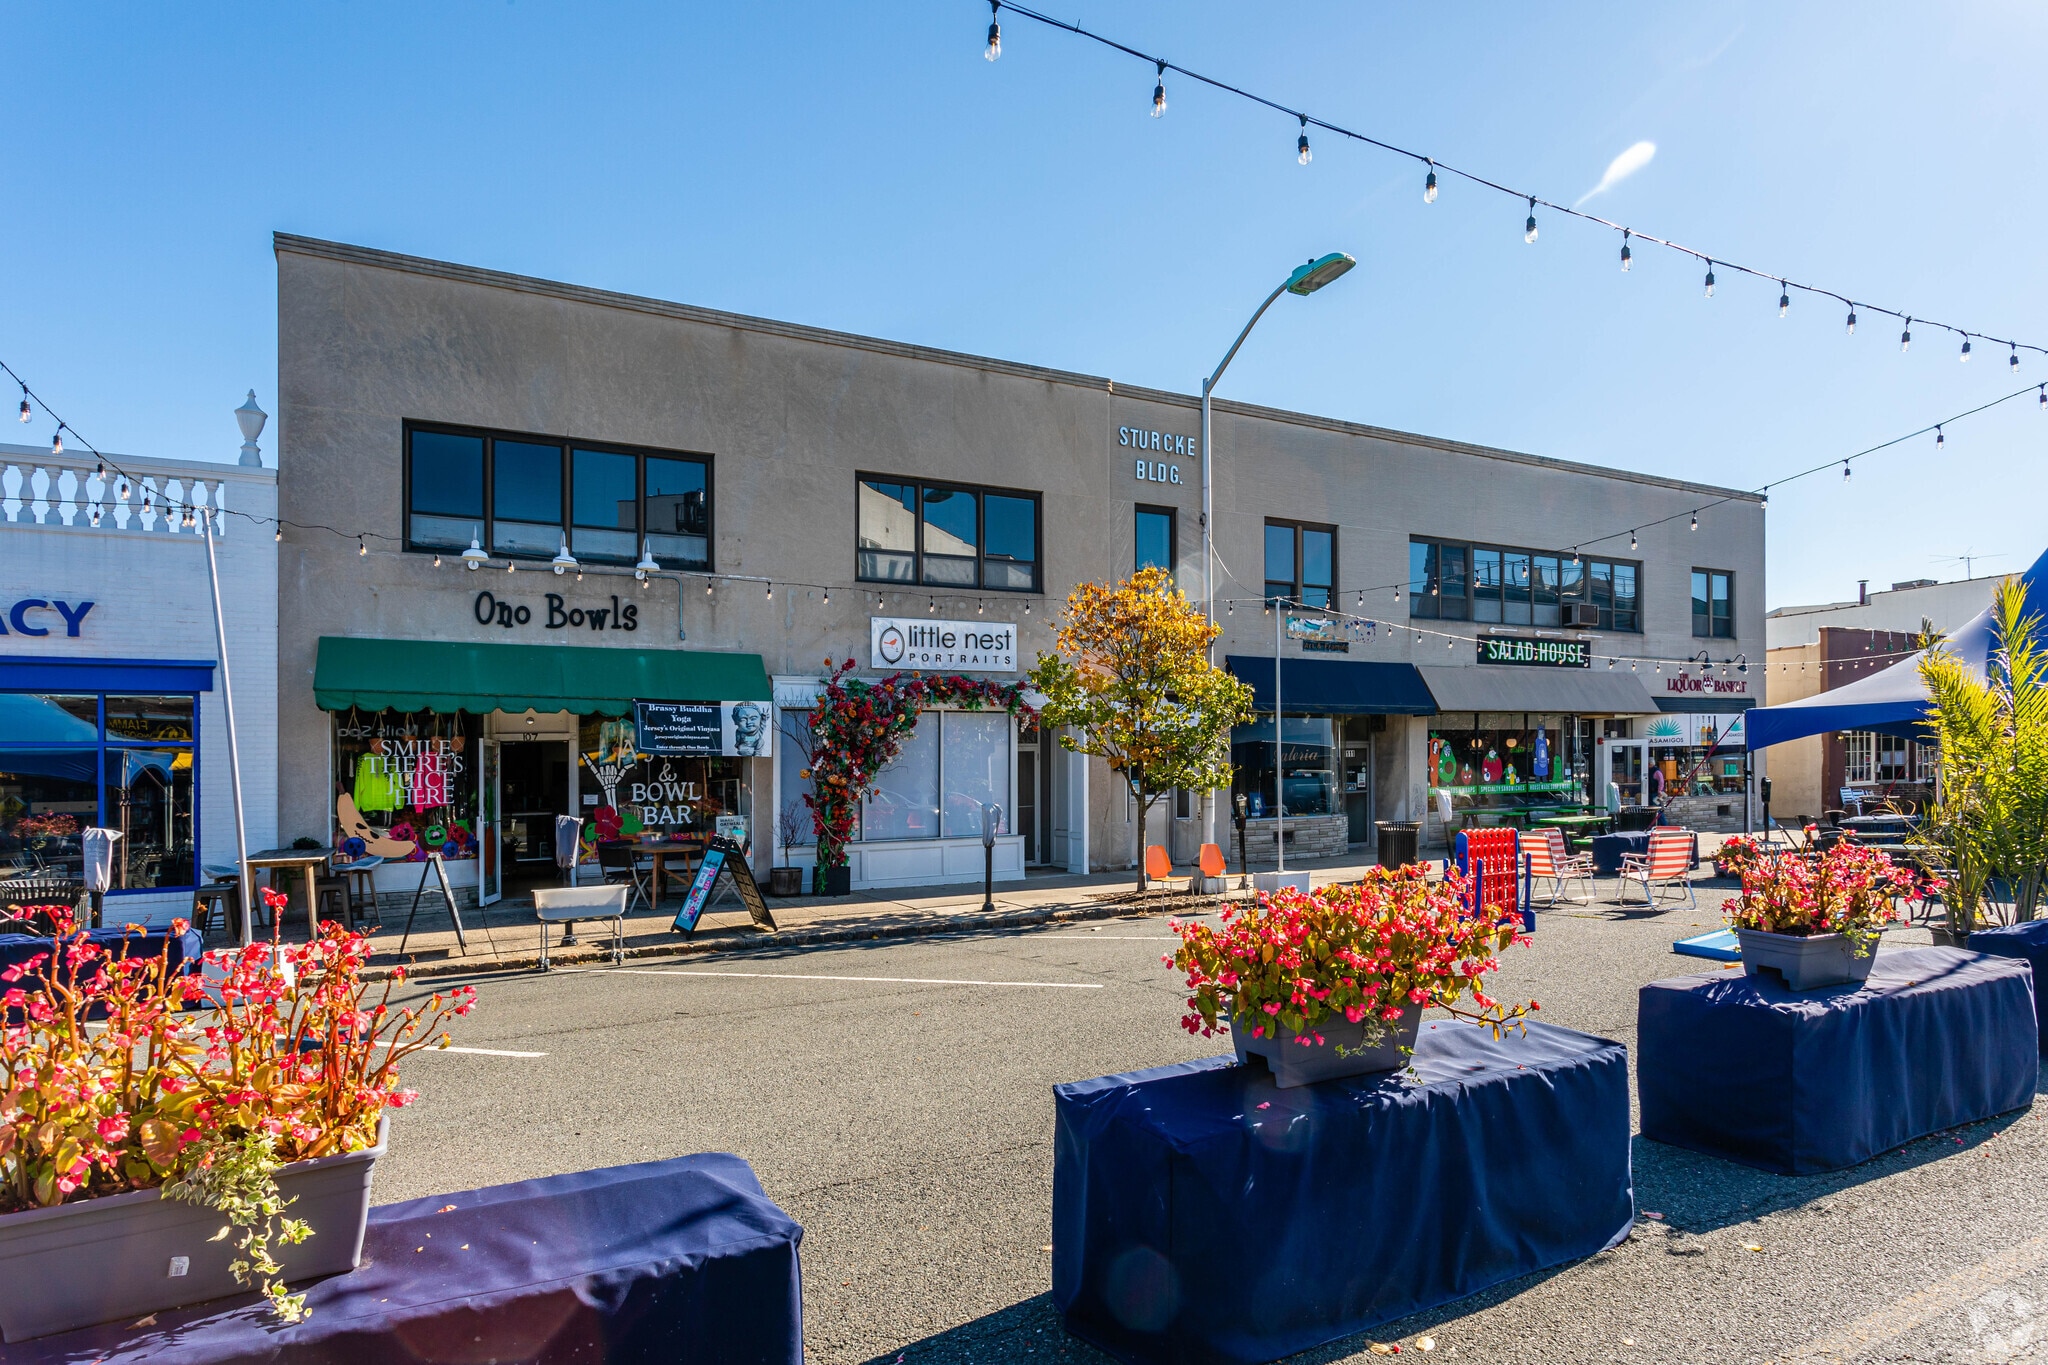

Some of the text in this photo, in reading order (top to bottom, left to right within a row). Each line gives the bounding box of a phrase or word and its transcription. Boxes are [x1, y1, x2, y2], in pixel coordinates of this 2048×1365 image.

[1118, 425, 1196, 457] STURCKE
[1135, 459, 1184, 485] BLDG.
[0, 598, 95, 637] CY
[474, 590, 638, 631] Ono Bowls
[908, 625, 1012, 651] little nest
[909, 652, 1011, 665] PORTRAITS
[1487, 639, 1585, 664] SALAD HOUSE
[1667, 678, 1702, 693] LIQUOR
[648, 703, 713, 714] Brassy Buddha
[670, 714, 692, 724] Yoga
[523, 732, 539, 742] 107
[643, 725, 721, 733] Jersey's Original Vinyasa
[658, 763, 678, 782] &
[385, 772, 455, 795] JUICE
[631, 782, 702, 802] BOWL
[1480, 785, 1501, 793] SPECIALTY
[394, 787, 455, 805] HERE
[643, 805, 693, 826] BAR
